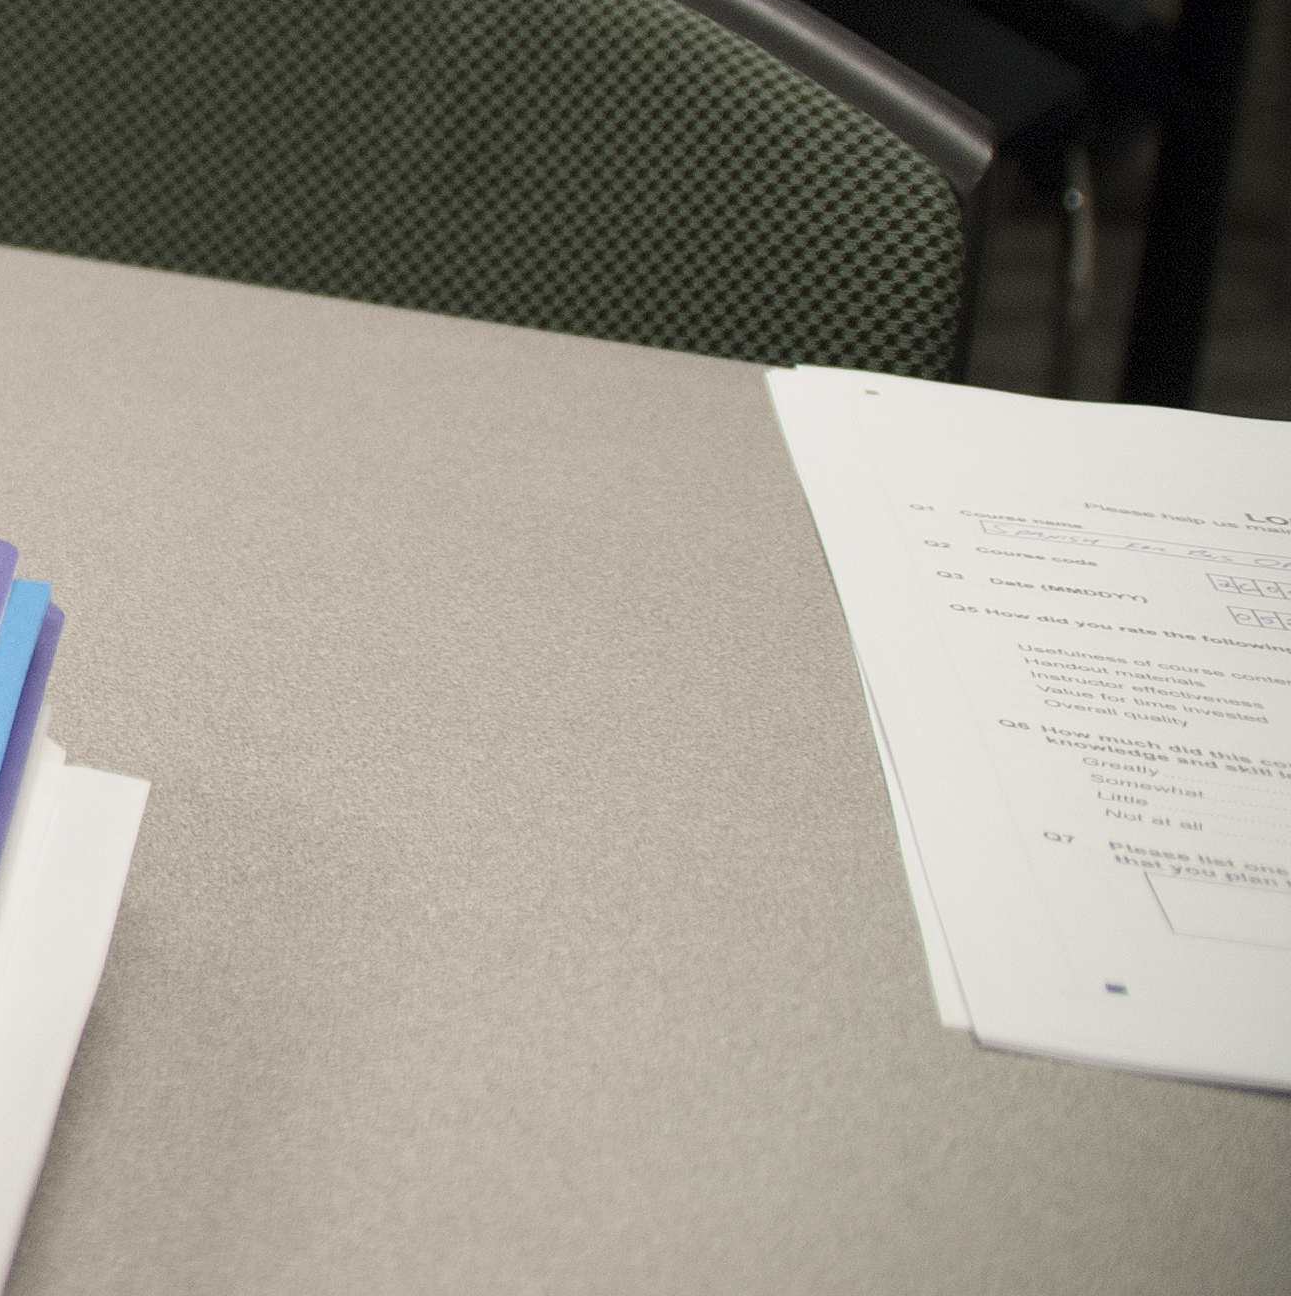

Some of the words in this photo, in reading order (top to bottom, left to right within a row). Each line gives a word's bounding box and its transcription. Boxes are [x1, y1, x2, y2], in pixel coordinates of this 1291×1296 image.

[960, 509, 1027, 522] Course
[1033, 519, 1083, 529] name
[1084, 502, 1154, 519] Please
[1162, 511, 1205, 527] help
[1245, 512, 1291, 526] LO
[923, 540, 952, 550] Q2
[975, 546, 1046, 561] Course
[1051, 556, 1098, 568] code
[989, 577, 1035, 590] Date
[1041, 582, 1149, 604] (MMDDYY)
[985, 607, 1031, 621] How
[1037, 614, 1069, 627] did
[1074, 620, 1113, 632] you
[1119, 626, 1157, 638] rate
[1163, 630, 1197, 642] the
[1017, 643, 1128, 664] Usefulness
[1134, 659, 1153, 668] of
[1158, 661, 1225, 678] course
[1024, 656, 1110, 675] Handout
[1115, 669, 1206, 688] materials
[1030, 670, 1125, 690] Instructor
[1132, 683, 1265, 710] effectiveness
[1036, 684, 1094, 699] Value
[1101, 692, 1127, 704] for
[1133, 697, 1177, 712] time
[1183, 704, 1269, 725] invested
[1043, 698, 1119, 717] Overall
[1124, 710, 1189, 729] quality
[998, 718, 1031, 730] Q6
[1040, 724, 1092, 740] How
[1098, 733, 1162, 751] much
[1169, 743, 1203, 757] did
[1209, 750, 1253, 764] this
[1260, 759, 1291, 768] co
[1045, 735, 1170, 762] knowledge
[1177, 756, 1219, 770] and
[1226, 764, 1274, 778] skill
[1081, 757, 1160, 778] Greatly
[1090, 773, 1205, 799] Somewhat
[1097, 790, 1149, 806] Little
[1105, 808, 1145, 823] Not
[1151, 816, 1173, 827] at
[1179, 820, 1204, 831] all
[1043, 830, 1076, 844] Q7
[1108, 840, 1191, 863] Please
[1197, 853, 1235, 868] list
[1244, 863, 1290, 876] one
[1113, 854, 1164, 871] that
[1169, 864, 1217, 878] you
[1225, 871, 1279, 889] plan
